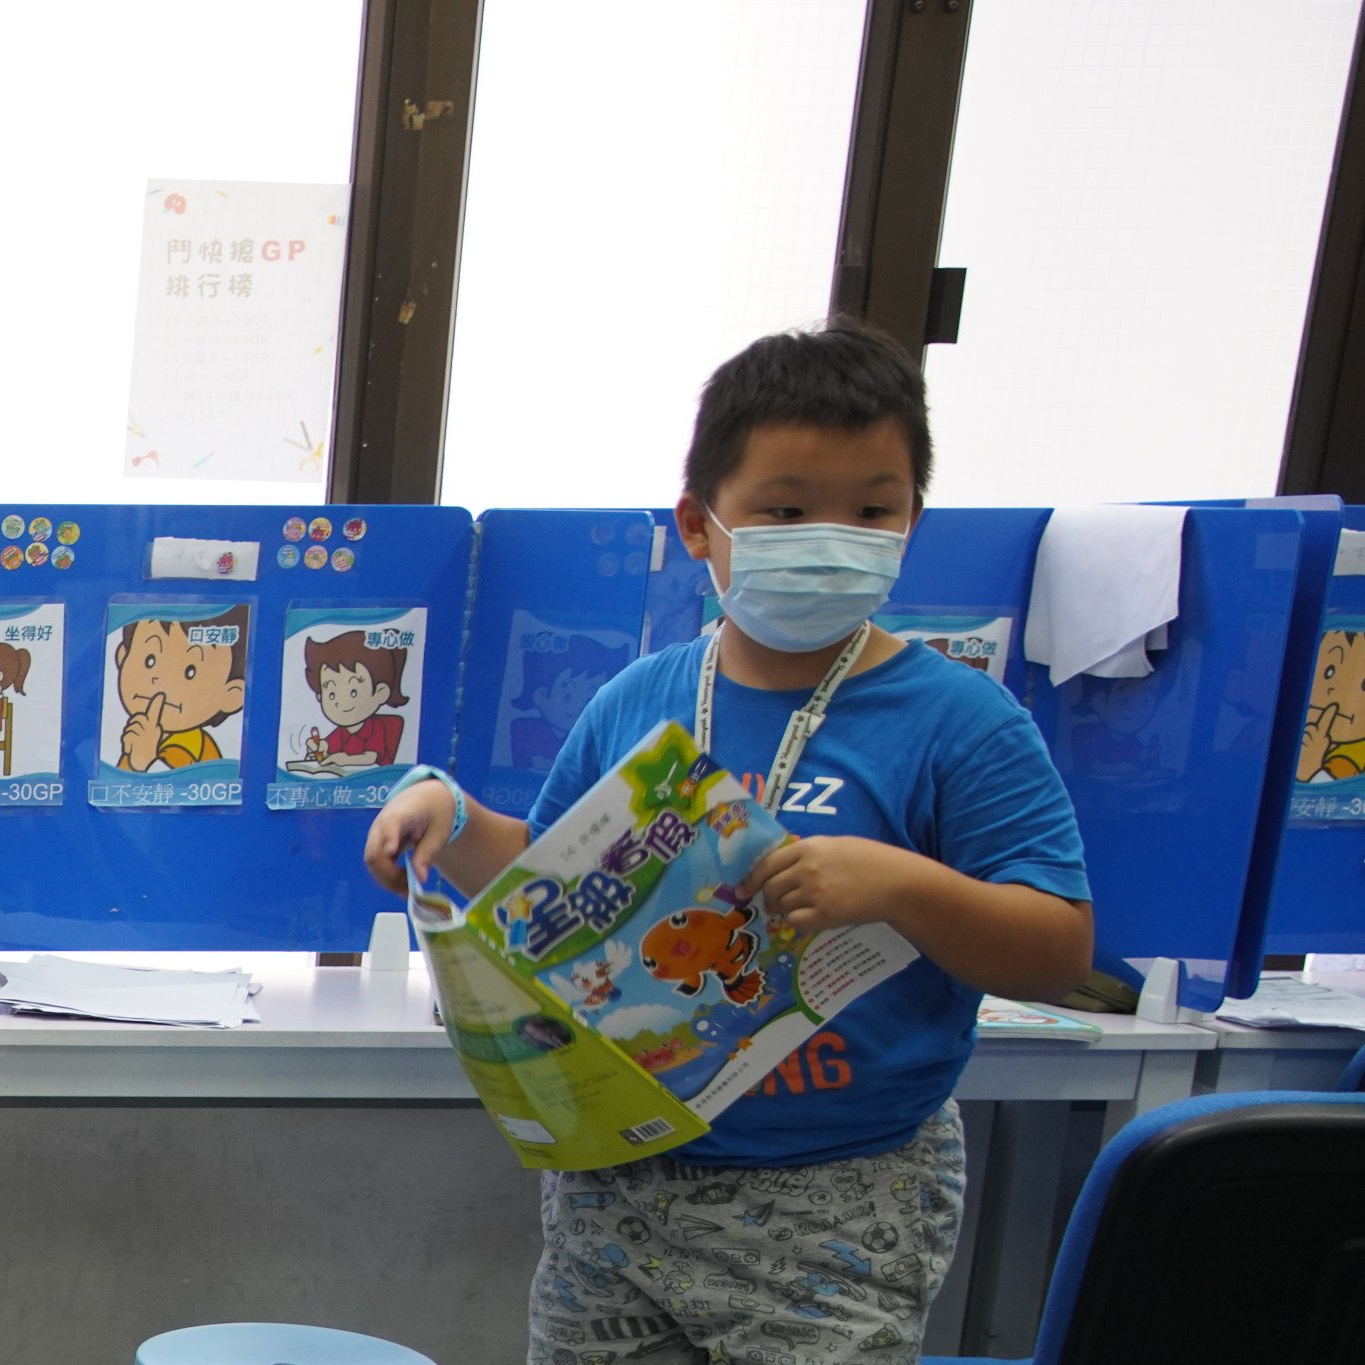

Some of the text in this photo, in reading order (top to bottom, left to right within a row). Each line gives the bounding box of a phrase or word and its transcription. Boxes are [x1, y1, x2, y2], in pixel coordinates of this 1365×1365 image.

[166, 273, 253, 298] 排行榜
[5, 624, 53, 642] 坐得好
[188, 626, 237, 646] 口安靜
[366, 630, 415, 649] 專心做
[950, 639, 997, 657] 專心做
[1, 783, 63, 801] -30GP
[91, 783, 241, 805] 口不安靜 -30GP
[268, 784, 352, 807] 不專心做
